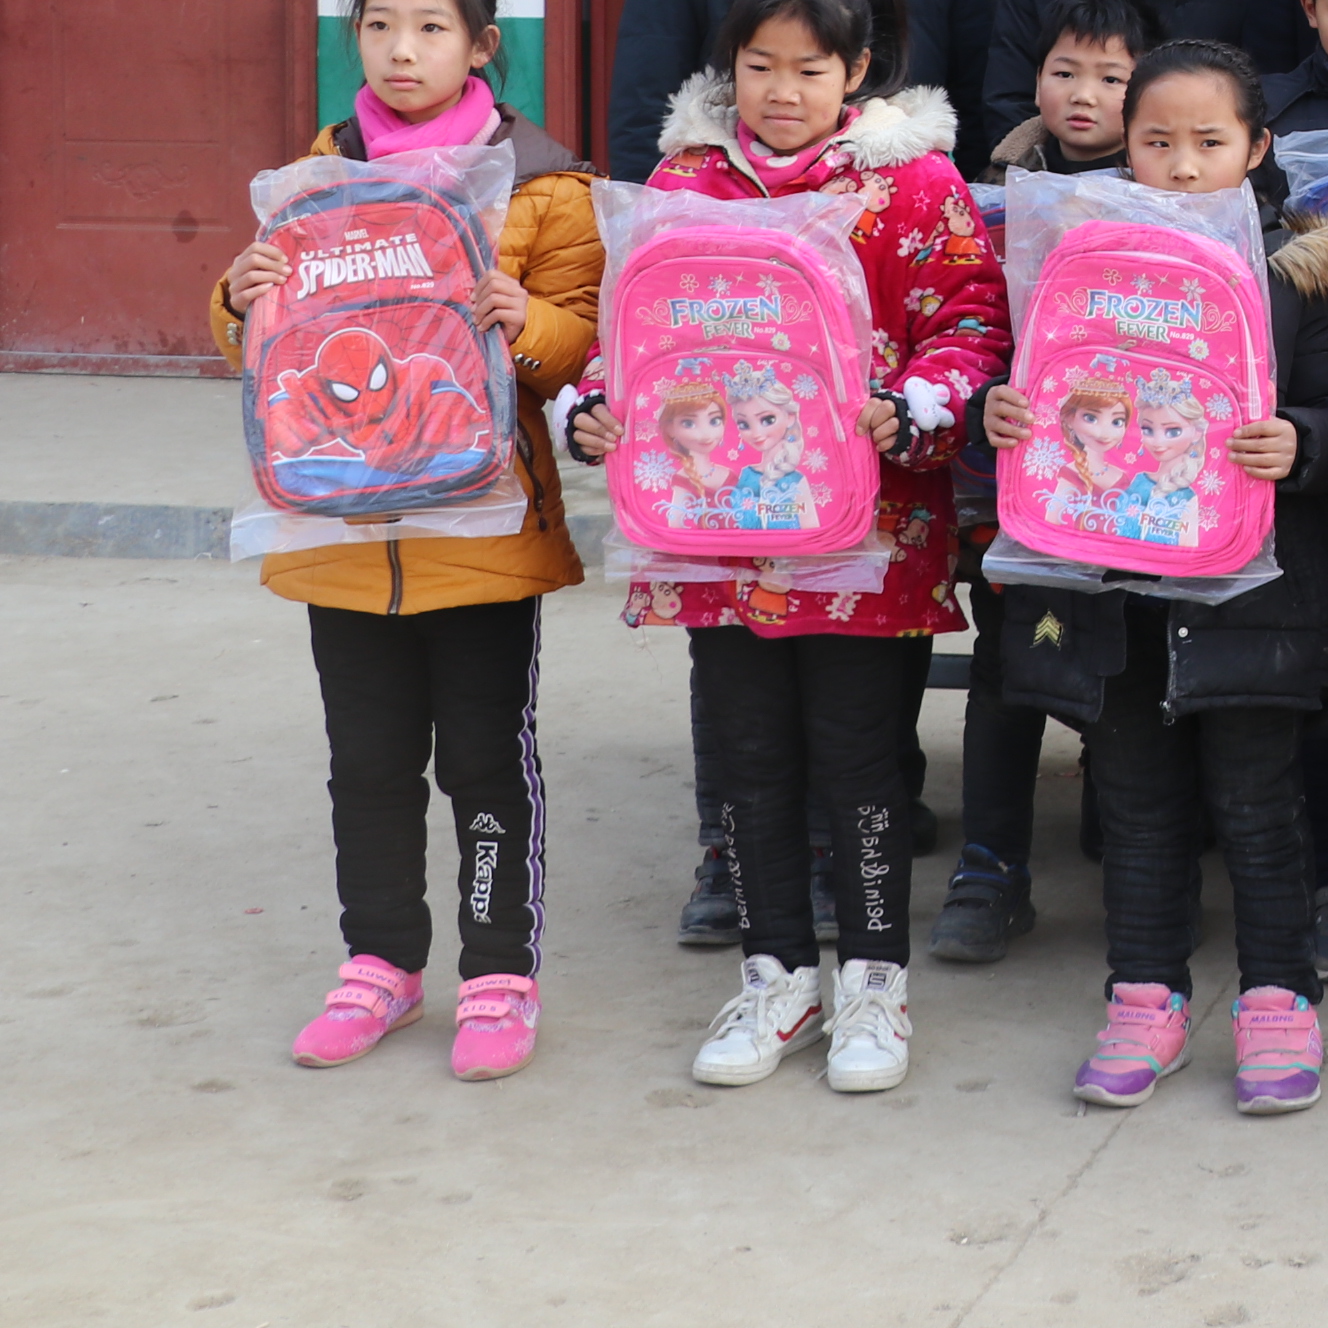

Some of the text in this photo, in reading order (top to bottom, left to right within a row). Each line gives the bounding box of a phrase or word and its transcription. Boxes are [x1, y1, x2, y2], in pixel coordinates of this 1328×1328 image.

[301, 233, 418, 260] ULTIMATE
[344, 228, 369, 241] MARVEL
[297, 243, 434, 300] SPIDER-MAN
[668, 294, 782, 329] FROZEN
[1085, 289, 1202, 331] FROZEN
[702, 321, 755, 340] FEVER
[1115, 319, 1170, 344] FEVER
[757, 503, 806, 516] FROZEN
[1140, 512, 1190, 534] FROZEN
